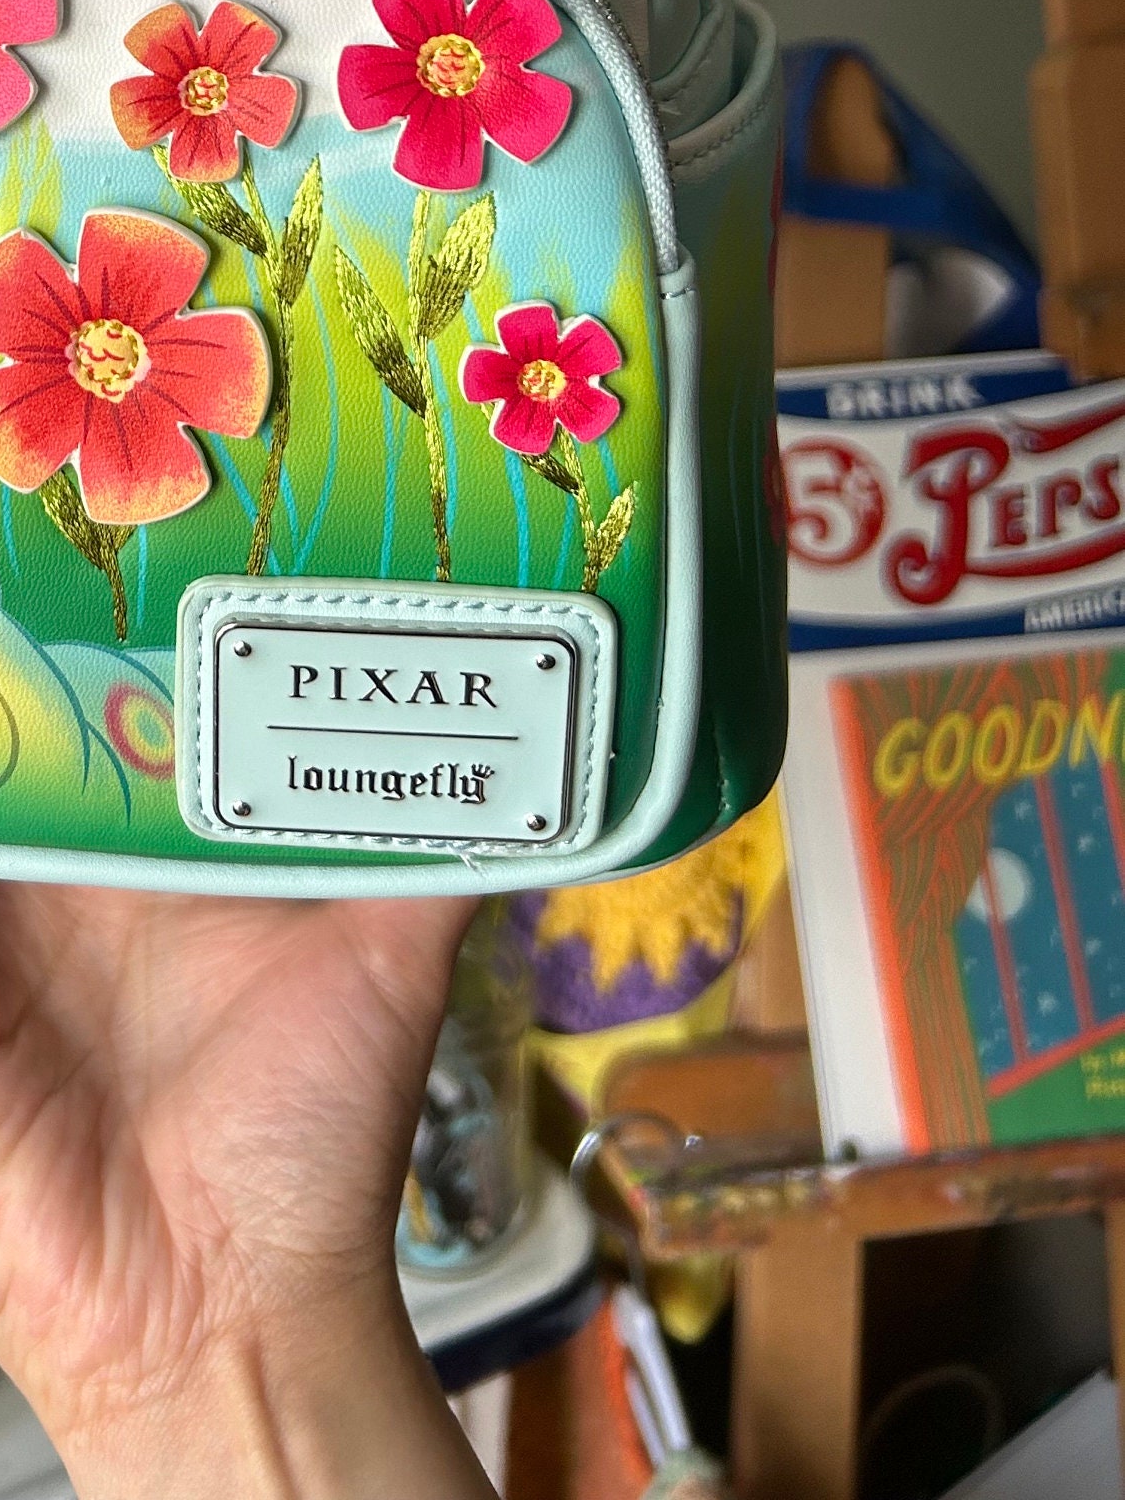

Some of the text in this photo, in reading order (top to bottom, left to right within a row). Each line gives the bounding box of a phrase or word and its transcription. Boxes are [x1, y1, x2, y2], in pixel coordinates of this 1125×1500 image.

[826, 375, 982, 420] DRINK
[288, 664, 498, 708] PIXAR
[287, 754, 495, 805] loungefly
